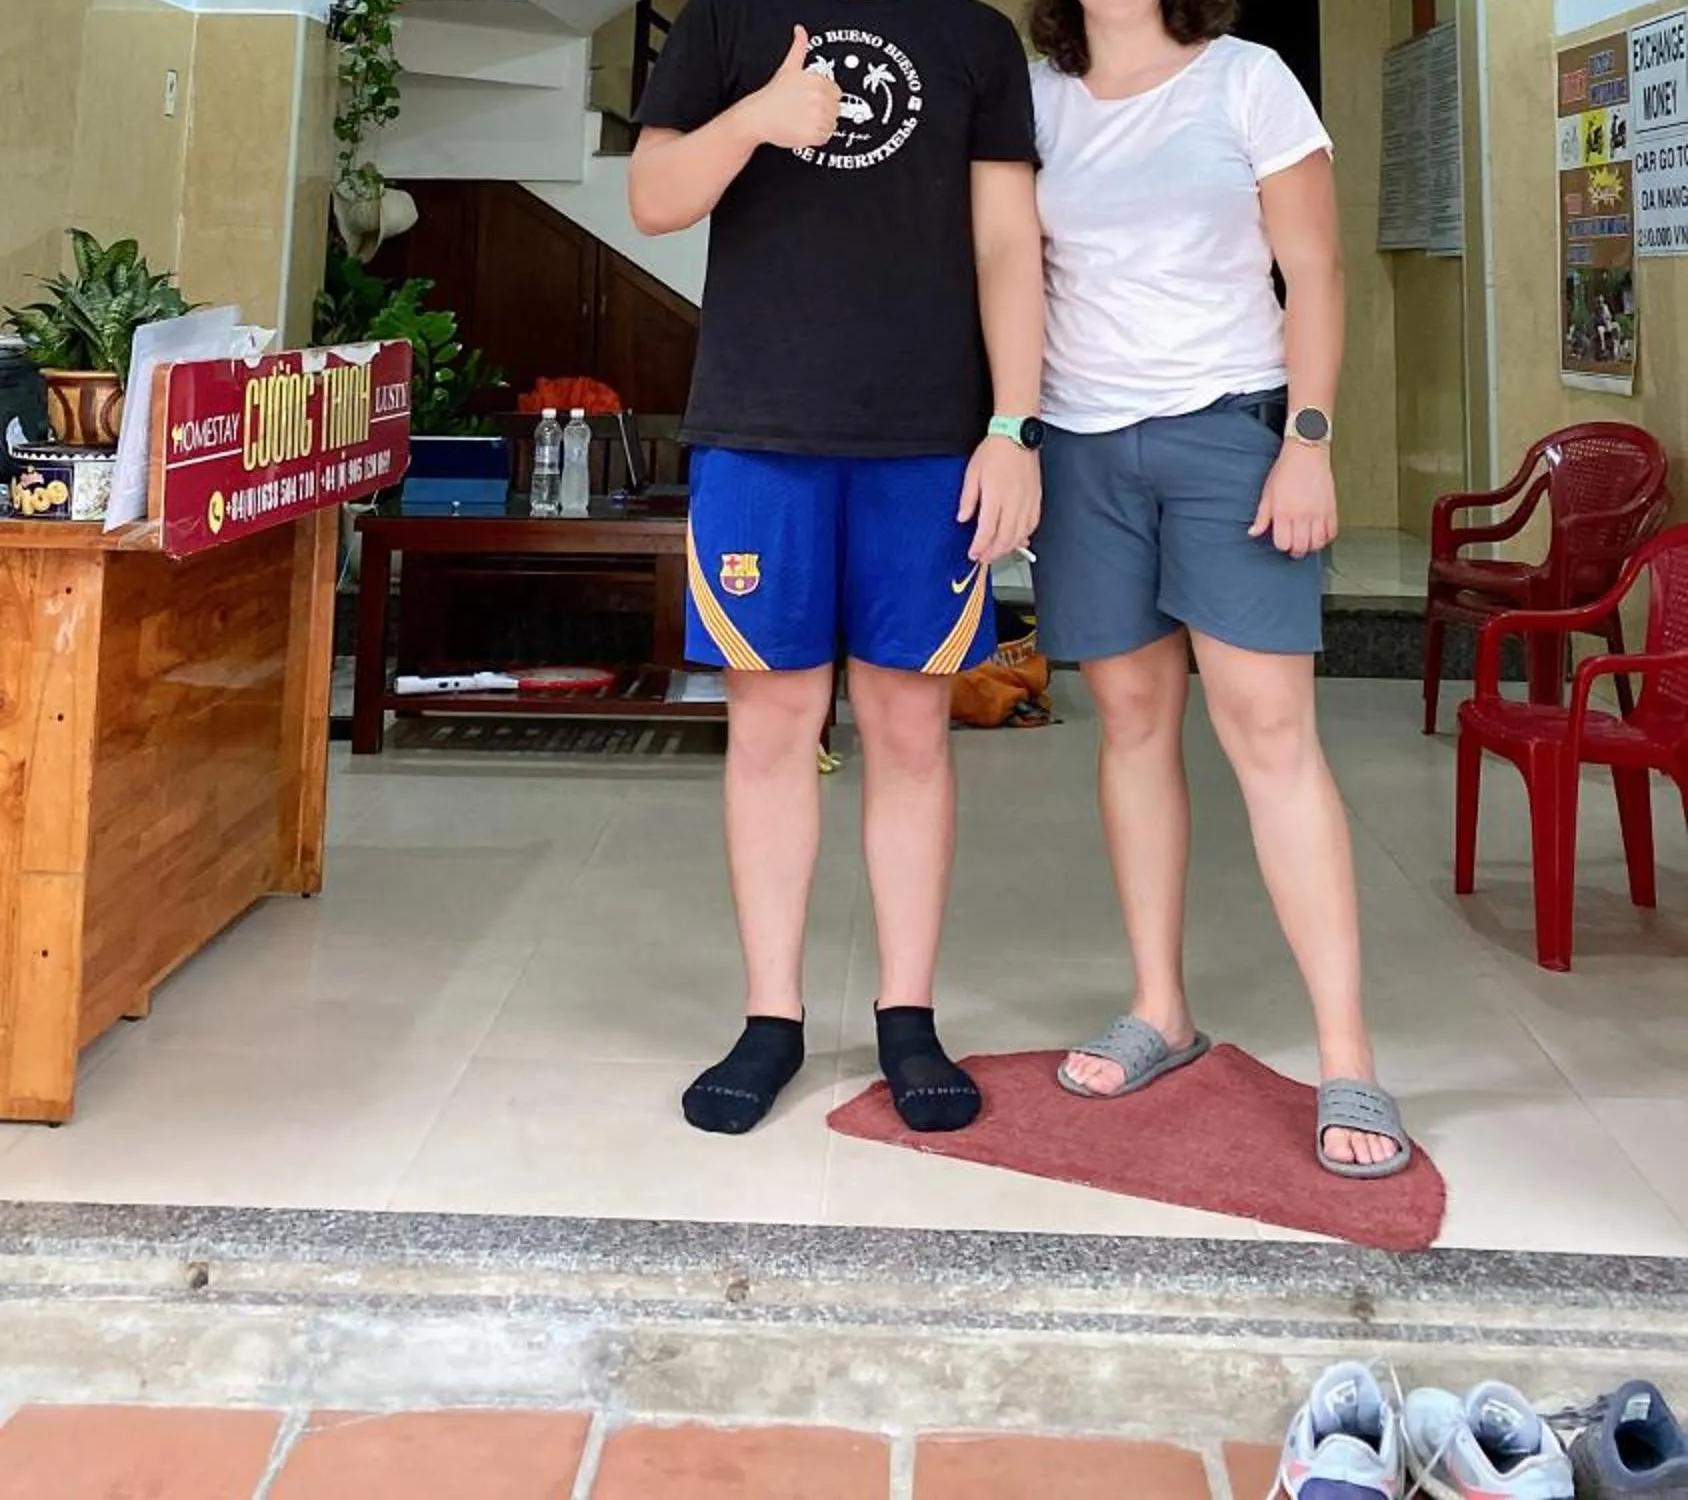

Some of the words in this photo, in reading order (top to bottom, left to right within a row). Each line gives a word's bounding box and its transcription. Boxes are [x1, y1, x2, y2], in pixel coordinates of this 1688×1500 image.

[825, 29, 884, 48] BUENO
[882, 42, 923, 92] BUENO
[1633, 23, 1685, 72] EXCHANGE
[1643, 80, 1678, 121] MONEY
[827, 116, 918, 169] MERITXELL
[1636, 151, 1657, 173] CAR
[1660, 147, 1675, 170] GO
[172, 412, 240, 454] HOMESTAY
[375, 381, 409, 413] LUSTY
